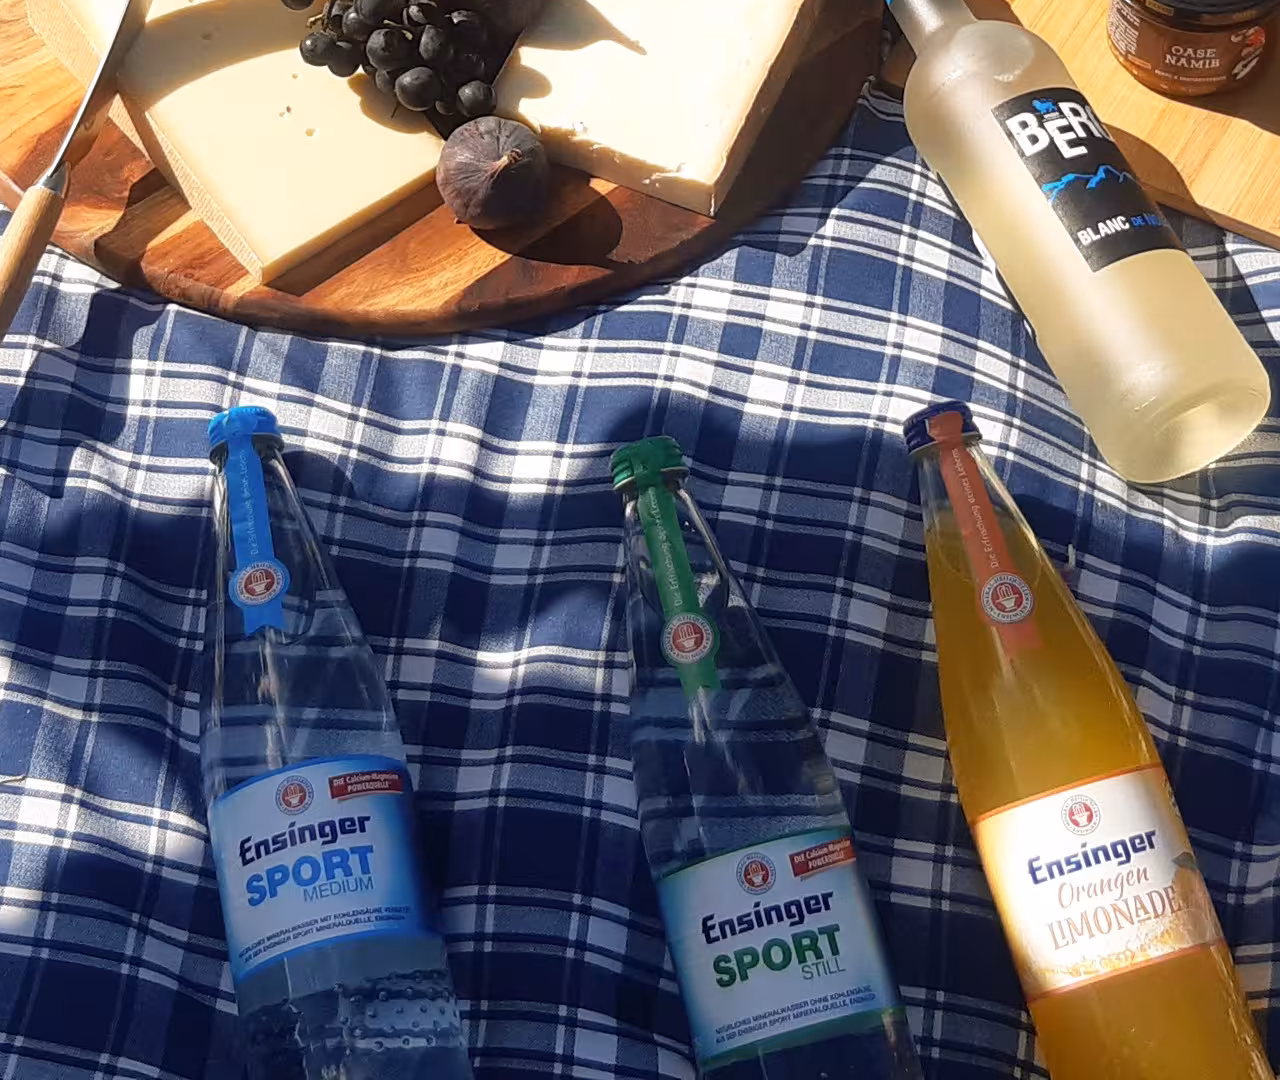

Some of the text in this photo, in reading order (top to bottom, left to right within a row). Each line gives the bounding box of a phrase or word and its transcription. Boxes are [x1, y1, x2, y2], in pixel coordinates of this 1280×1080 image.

[1165, 55, 1221, 70] NAMIB
[1171, 45, 1217, 59] OASE
[1077, 215, 1130, 247] BLANC
[971, 505, 993, 553] Erfrischung
[989, 552, 999, 568] Die
[239, 816, 371, 866] Ensinger
[1027, 829, 1157, 886] Ensinger
[246, 845, 374, 907] SPORT
[303, 875, 374, 903] MEDIUM
[1057, 866, 1150, 910] Orangen
[701, 890, 834, 945] Ensinger
[1046, 885, 1184, 951] LIMONADE
[712, 923, 841, 989] SPORT
[801, 955, 847, 981] STILL
